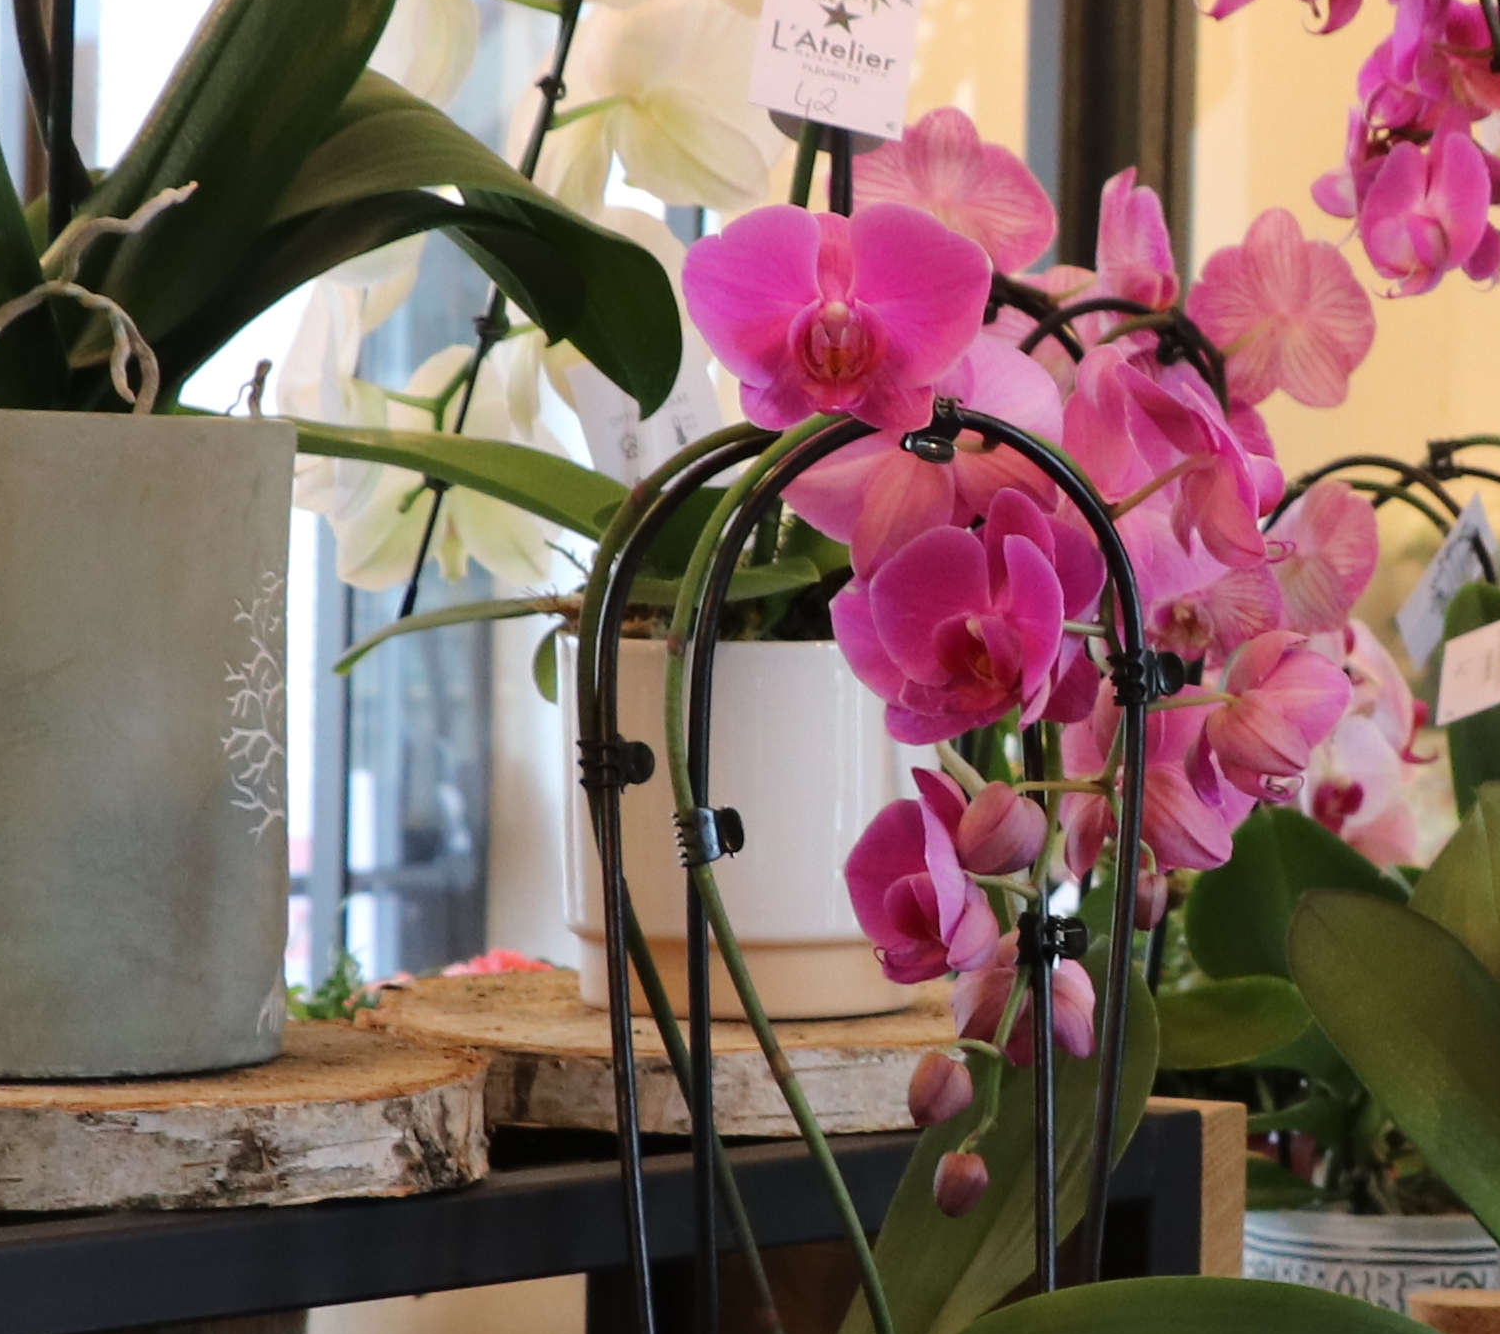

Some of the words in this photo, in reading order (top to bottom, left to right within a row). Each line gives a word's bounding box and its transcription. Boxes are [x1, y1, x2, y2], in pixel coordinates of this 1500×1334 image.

[771, 18, 896, 72] L'Atelier
[802, 63, 861, 85] FLEURISTE
[793, 80, 838, 117] 42
